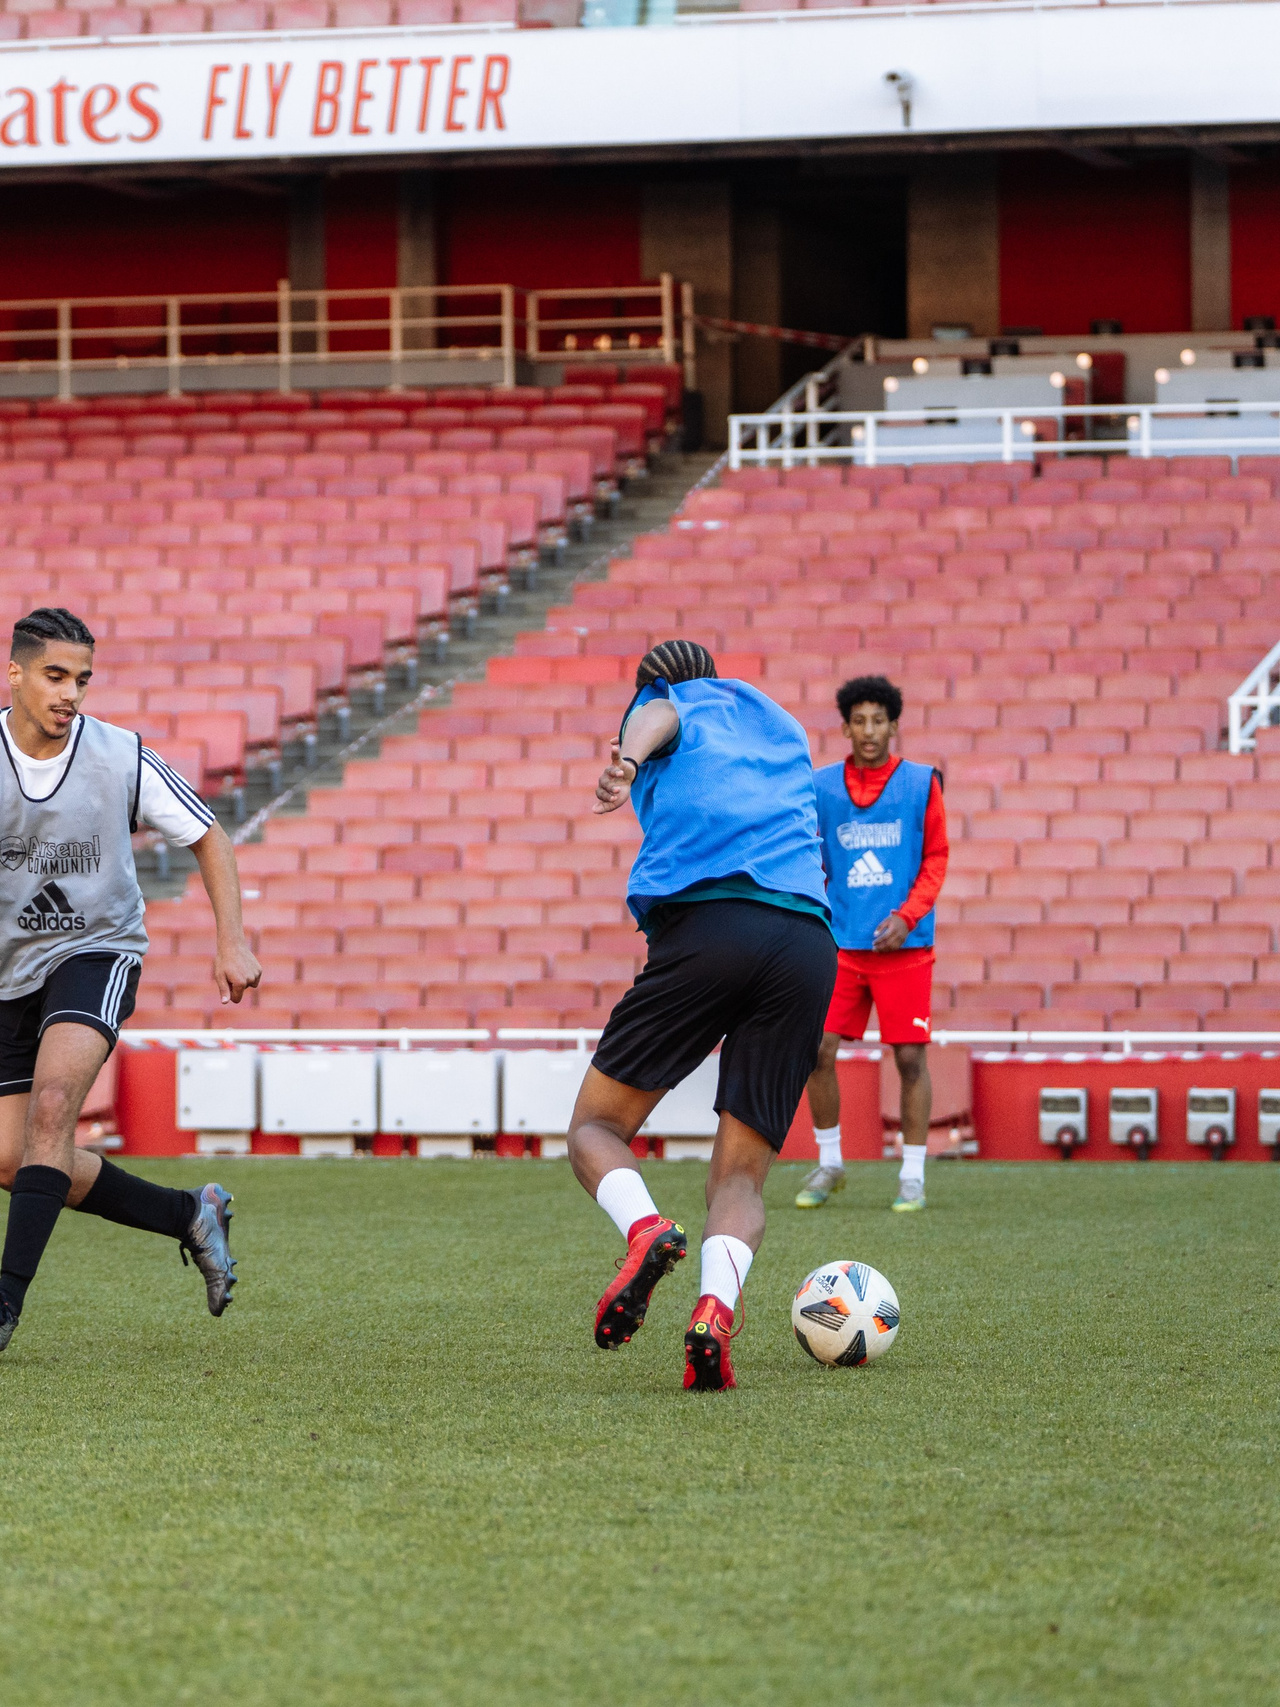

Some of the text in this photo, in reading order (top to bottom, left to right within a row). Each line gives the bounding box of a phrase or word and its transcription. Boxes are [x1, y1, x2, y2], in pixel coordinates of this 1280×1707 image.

[202, 61, 294, 141] FLY
[310, 53, 510, 136] BETTER
[27, 834, 101, 859] Arsenal
[27, 856, 101, 875] COMMUNITY
[17, 912, 86, 931] adidas
[815, 1276, 834, 1295] adidas
